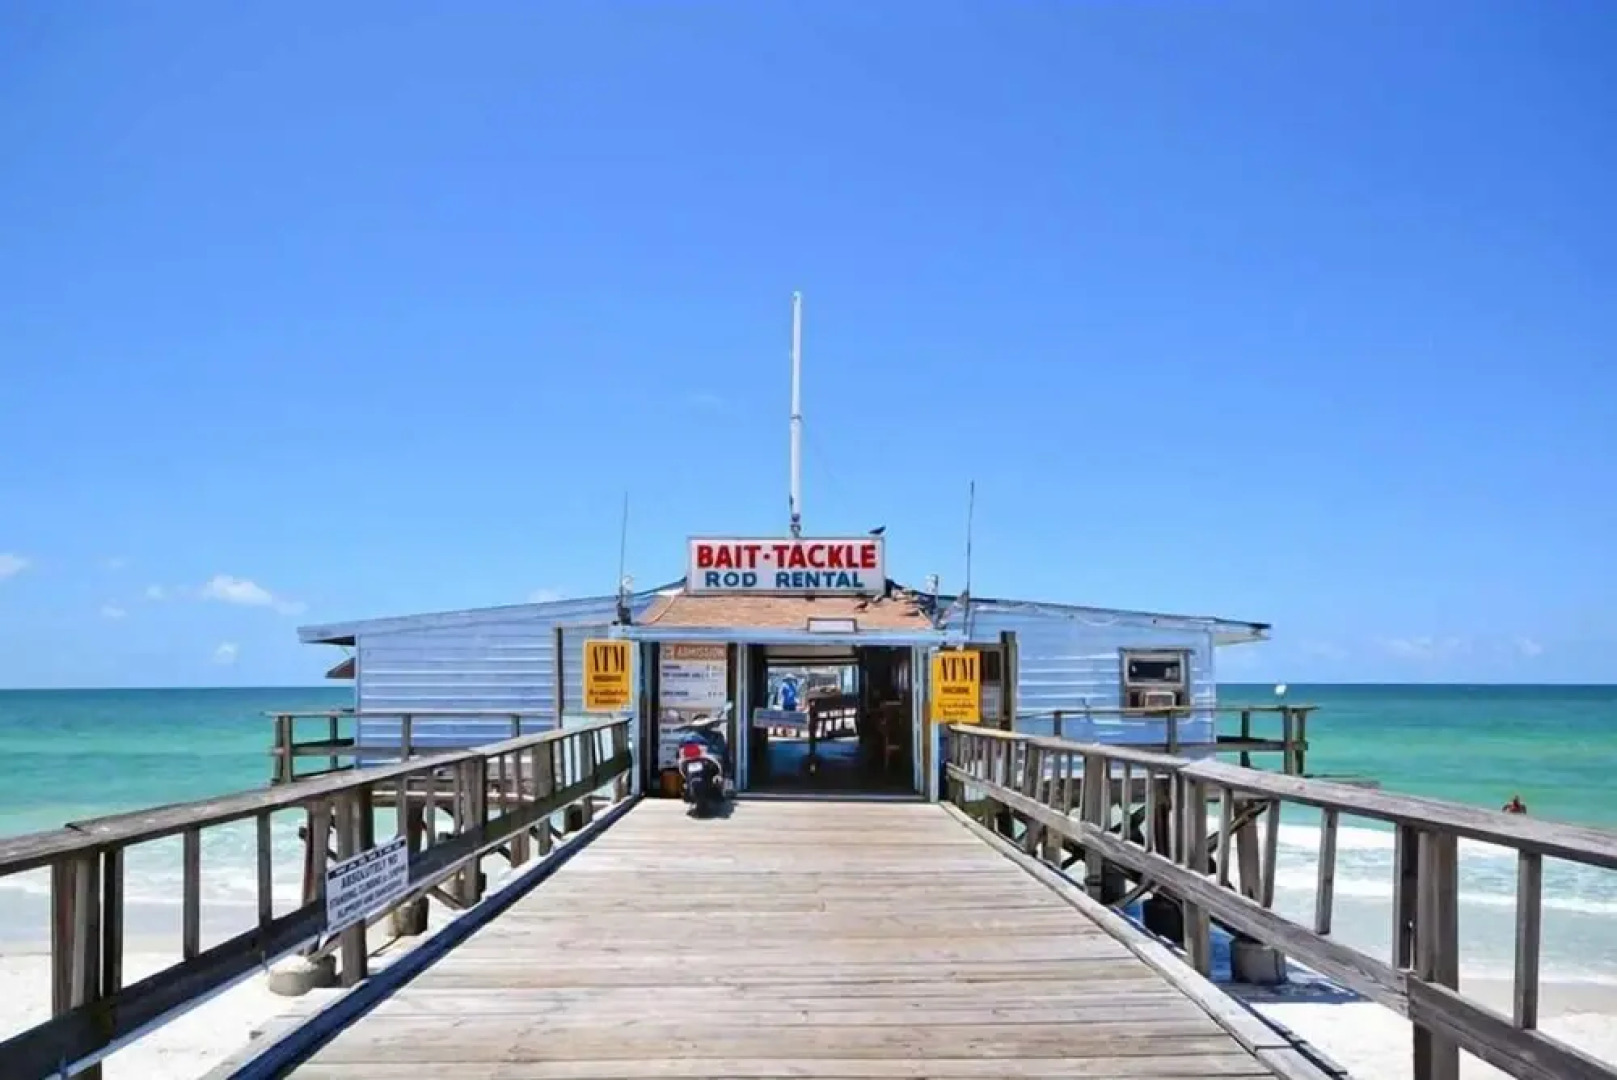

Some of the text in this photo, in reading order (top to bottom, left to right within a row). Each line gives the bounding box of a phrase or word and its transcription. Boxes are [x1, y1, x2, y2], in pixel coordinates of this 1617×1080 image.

[705, 571, 864, 588] ROD RENTAL
[593, 646, 625, 672] ATM
[941, 657, 975, 681] ATM
